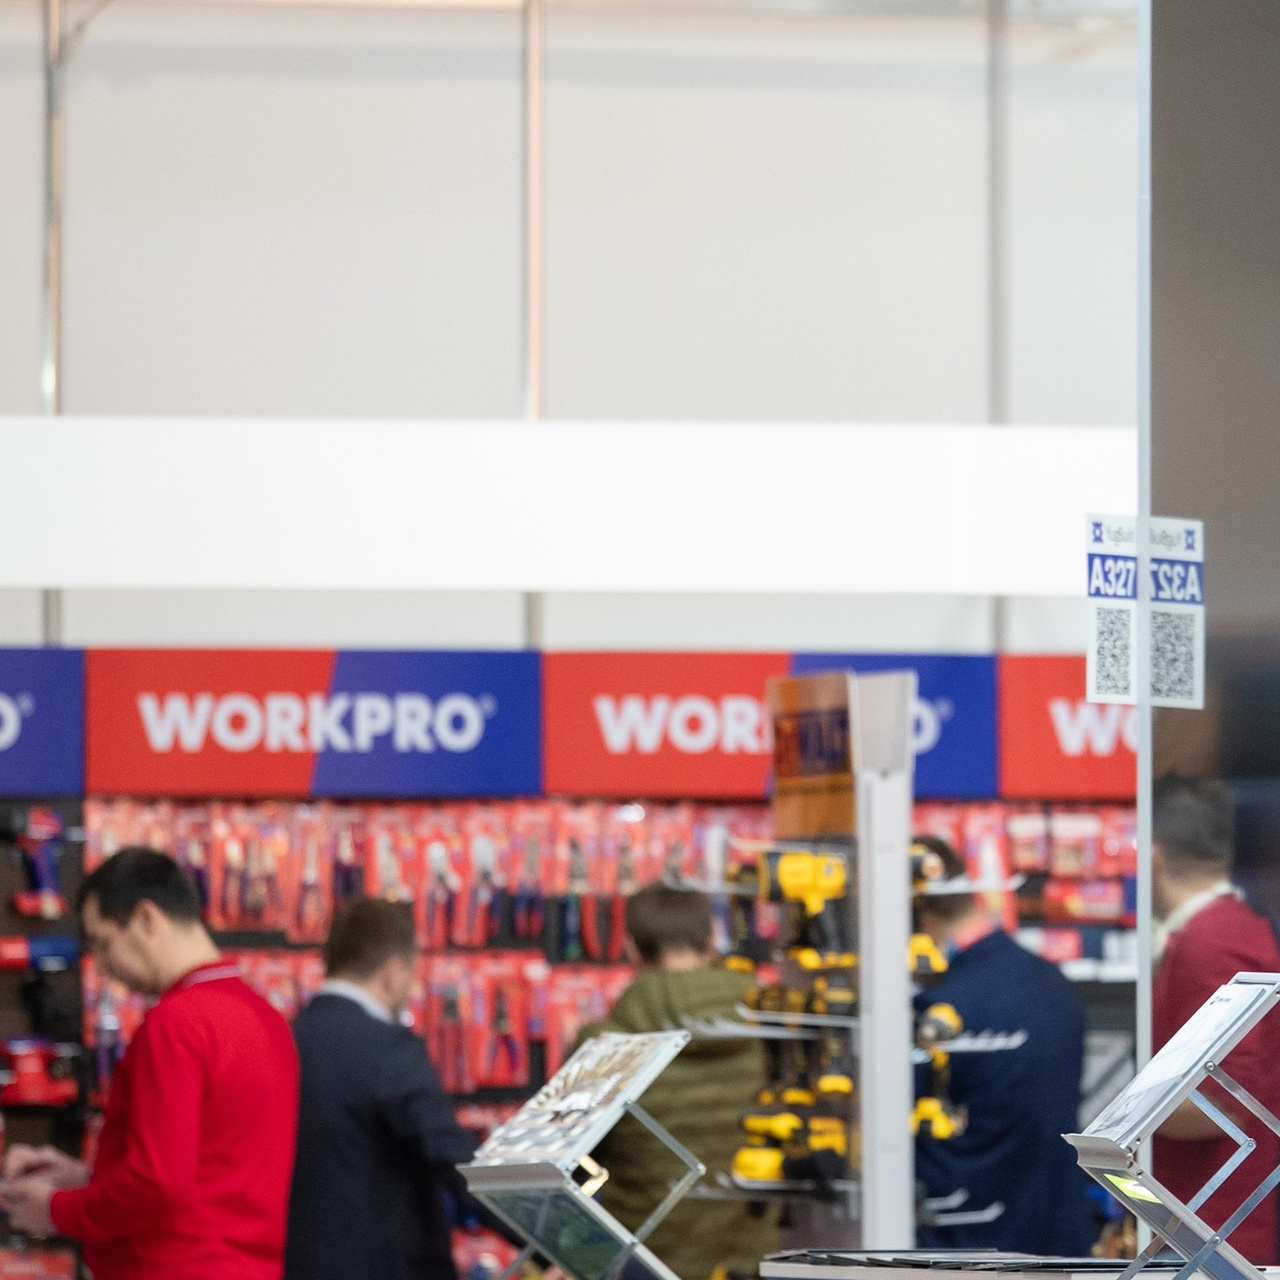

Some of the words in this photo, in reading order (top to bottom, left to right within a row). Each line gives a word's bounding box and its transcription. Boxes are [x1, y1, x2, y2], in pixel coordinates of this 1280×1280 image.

[1090, 557, 1136, 597] A327
[137, 692, 486, 753] WORKPRO
[593, 694, 940, 754] WORO
